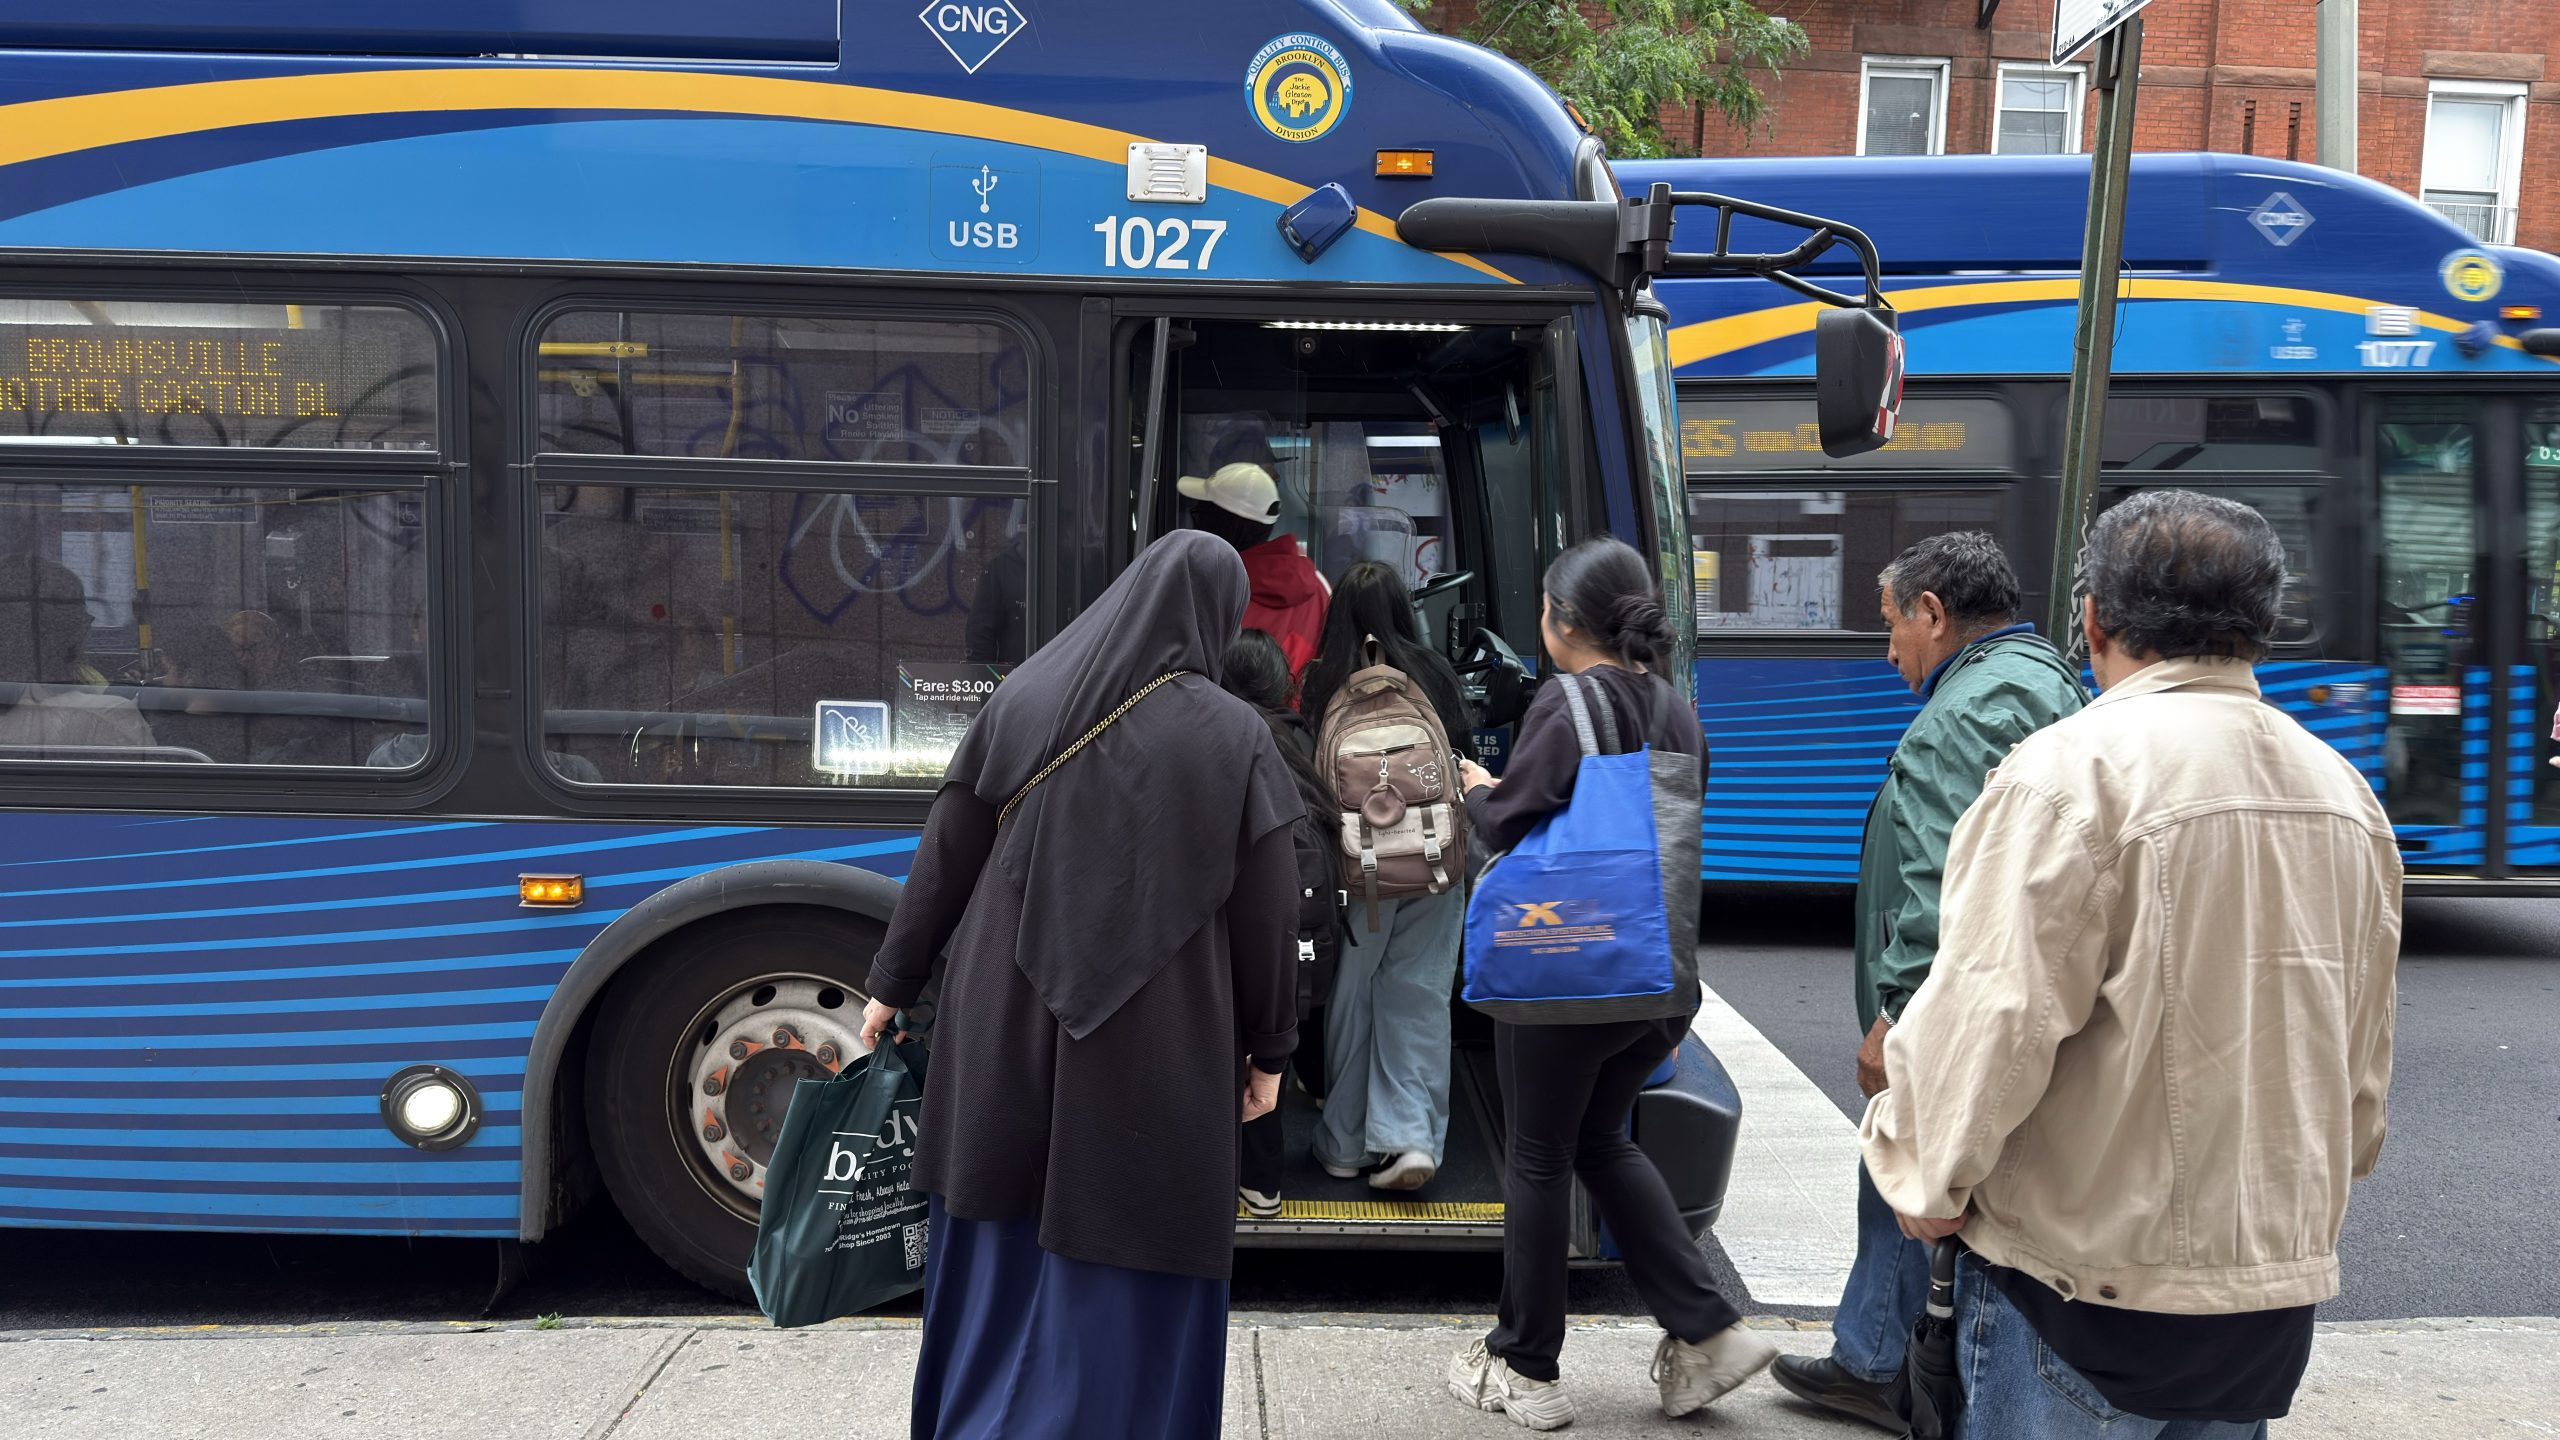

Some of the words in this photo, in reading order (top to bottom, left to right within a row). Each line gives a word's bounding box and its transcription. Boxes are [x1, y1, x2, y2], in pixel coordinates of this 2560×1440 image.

[937, 4, 1009, 36] CNG
[1249, 38, 1285, 74] QUALITY
[1290, 36, 1333, 57] CONTROL
[1333, 55, 1350, 77] BUS
[1275, 53, 1324, 68] BROOKLYN
[1285, 90, 1312, 98] Gleason
[1290, 83, 1311, 91] Jackie
[1275, 126, 1319, 139] DIVISION
[948, 220, 1019, 250] USB
[1094, 215, 1227, 272] 1027
[28, 338, 282, 376] BROWNSVILLE
[140, 379, 278, 415] GASTON
[297, 382, 339, 416] BL
[828, 394, 857, 402] Please
[829, 405, 859, 423] No
[864, 403, 899, 412] Littering
[863, 412, 899, 421] Smoking
[931, 411, 969, 420] NOTICE
[866, 422, 899, 430] Spitting
[840, 430, 866, 438] Radio
[869, 430, 900, 439] Playing
[914, 679, 949, 692] Fare:
[952, 679, 994, 693] $3.00
[915, 693, 929, 702] Tap
[946, 694, 961, 702] ride
[962, 694, 981, 702] with:
[1485, 735, 1497, 745] IS
[860, 1169, 886, 1181] LITY
[876, 1183, 894, 1197] Always
[896, 1180, 911, 1191] Hala
[866, 1222, 901, 1237] Hometown
[856, 1236, 875, 1247] Since
[875, 1232, 892, 1243] 2003
